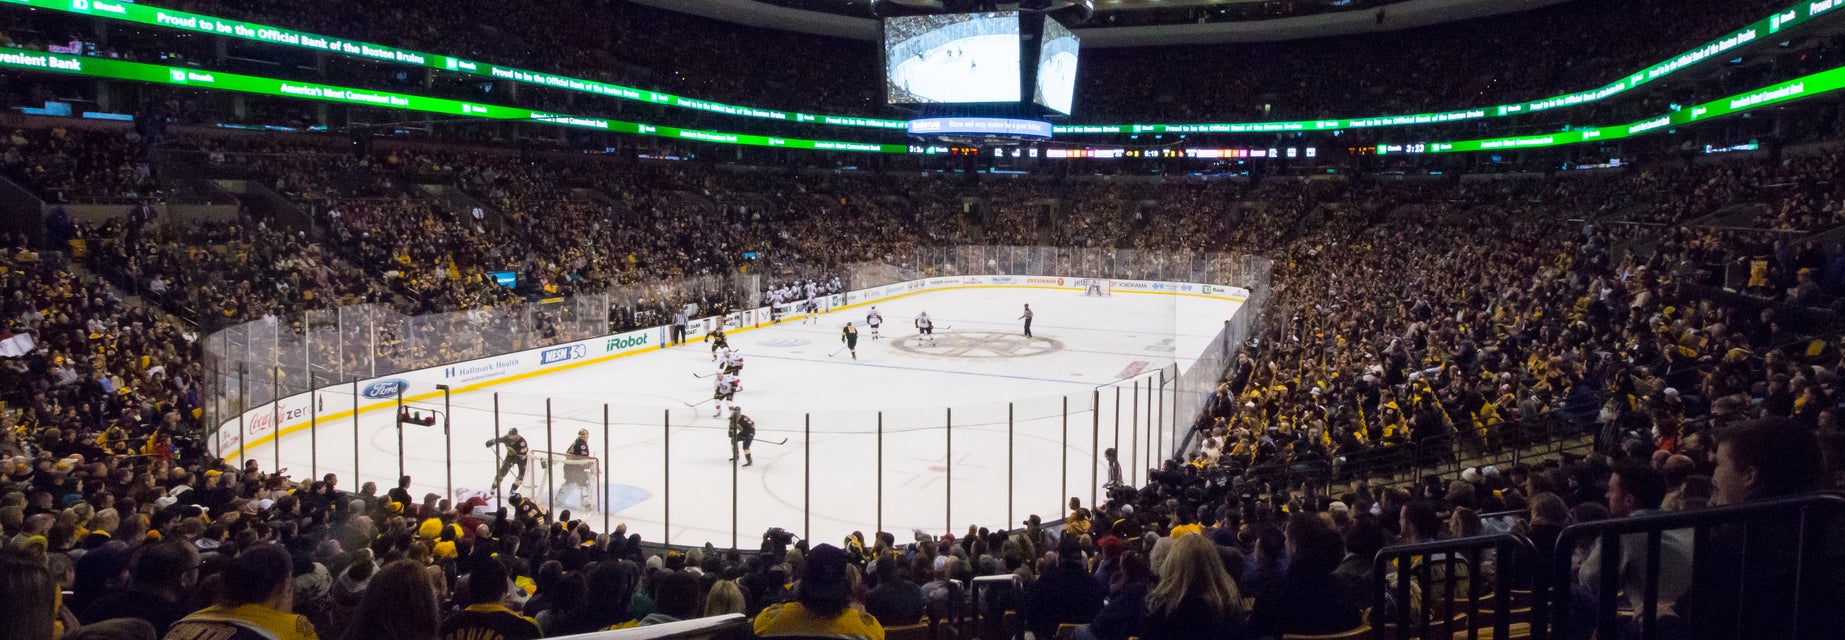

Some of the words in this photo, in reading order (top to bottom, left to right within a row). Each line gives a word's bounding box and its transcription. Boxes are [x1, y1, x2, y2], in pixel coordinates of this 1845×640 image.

[93, 1, 126, 14] Bank
[158, 12, 195, 27] Proud
[199, 20, 213, 30] to
[216, 22, 231, 33] be
[235, 26, 254, 36] the
[258, 29, 298, 43] Official
[301, 36, 327, 48] Bank
[330, 41, 340, 50] of
[343, 43, 360, 53] the
[362, 46, 394, 58] Boston
[396, 52, 424, 63] Bruins
[49, 57, 80, 70] Bank
[492, 68, 513, 77] Proud
[546, 77, 568, 86] Official
[281, 84, 322, 96] America's
[324, 89, 344, 98] Most
[346, 91, 389, 103] Convenient
[1406, 144, 1425, 153] 3:23
[606, 333, 648, 352] iRobot
[545, 348, 568, 362] NESN
[459, 365, 494, 377] Hallmark
[496, 359, 520, 370] Health
[370, 382, 400, 397] Ford
